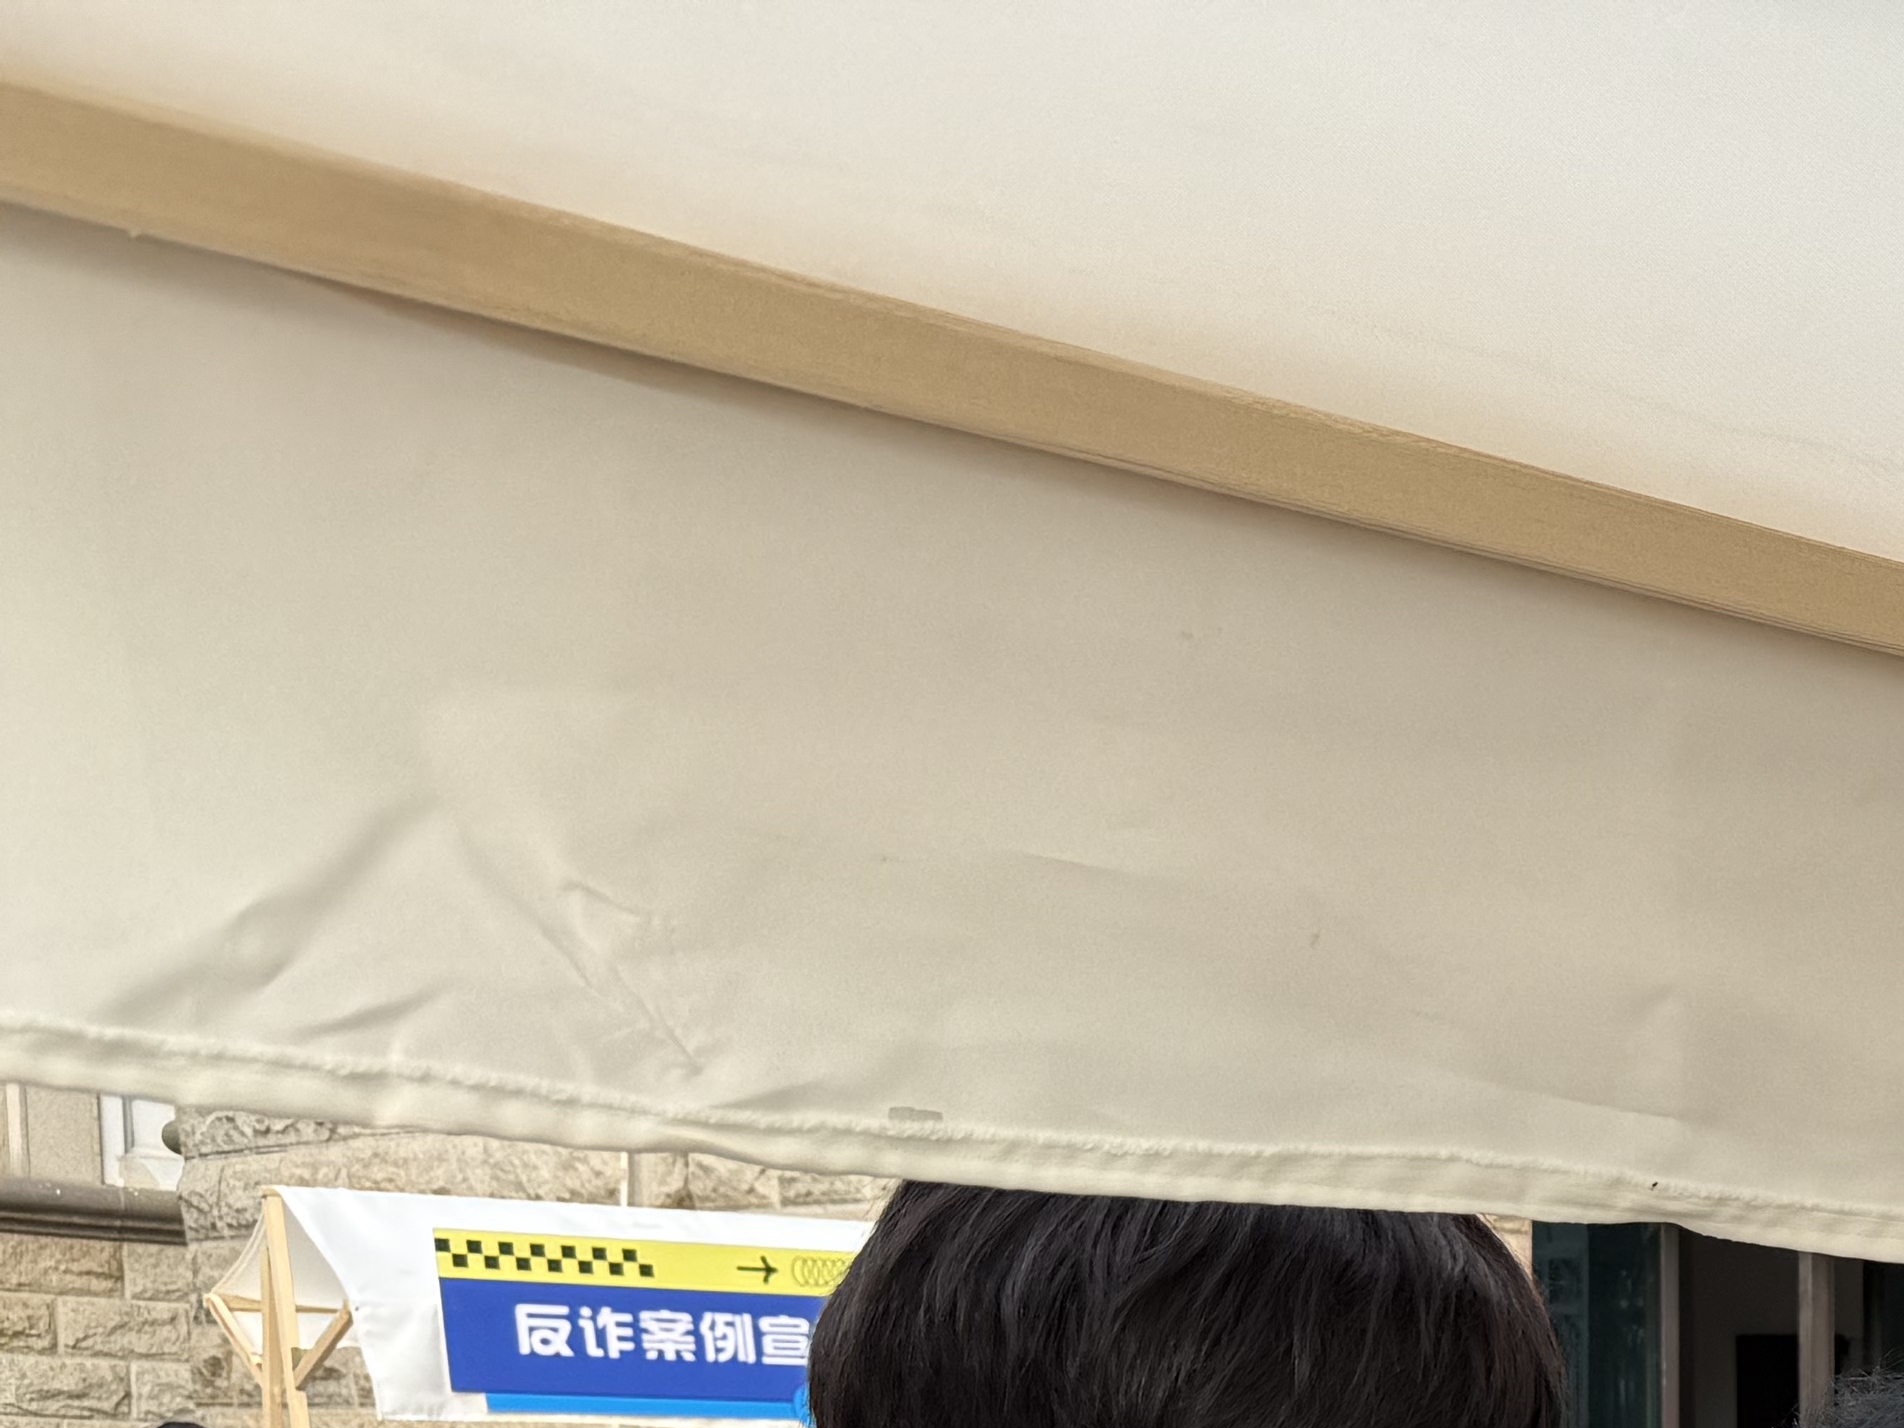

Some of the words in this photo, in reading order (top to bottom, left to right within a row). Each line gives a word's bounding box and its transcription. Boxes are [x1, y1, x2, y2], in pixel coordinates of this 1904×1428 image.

[515, 1303, 810, 1366] 反诈案例宣
